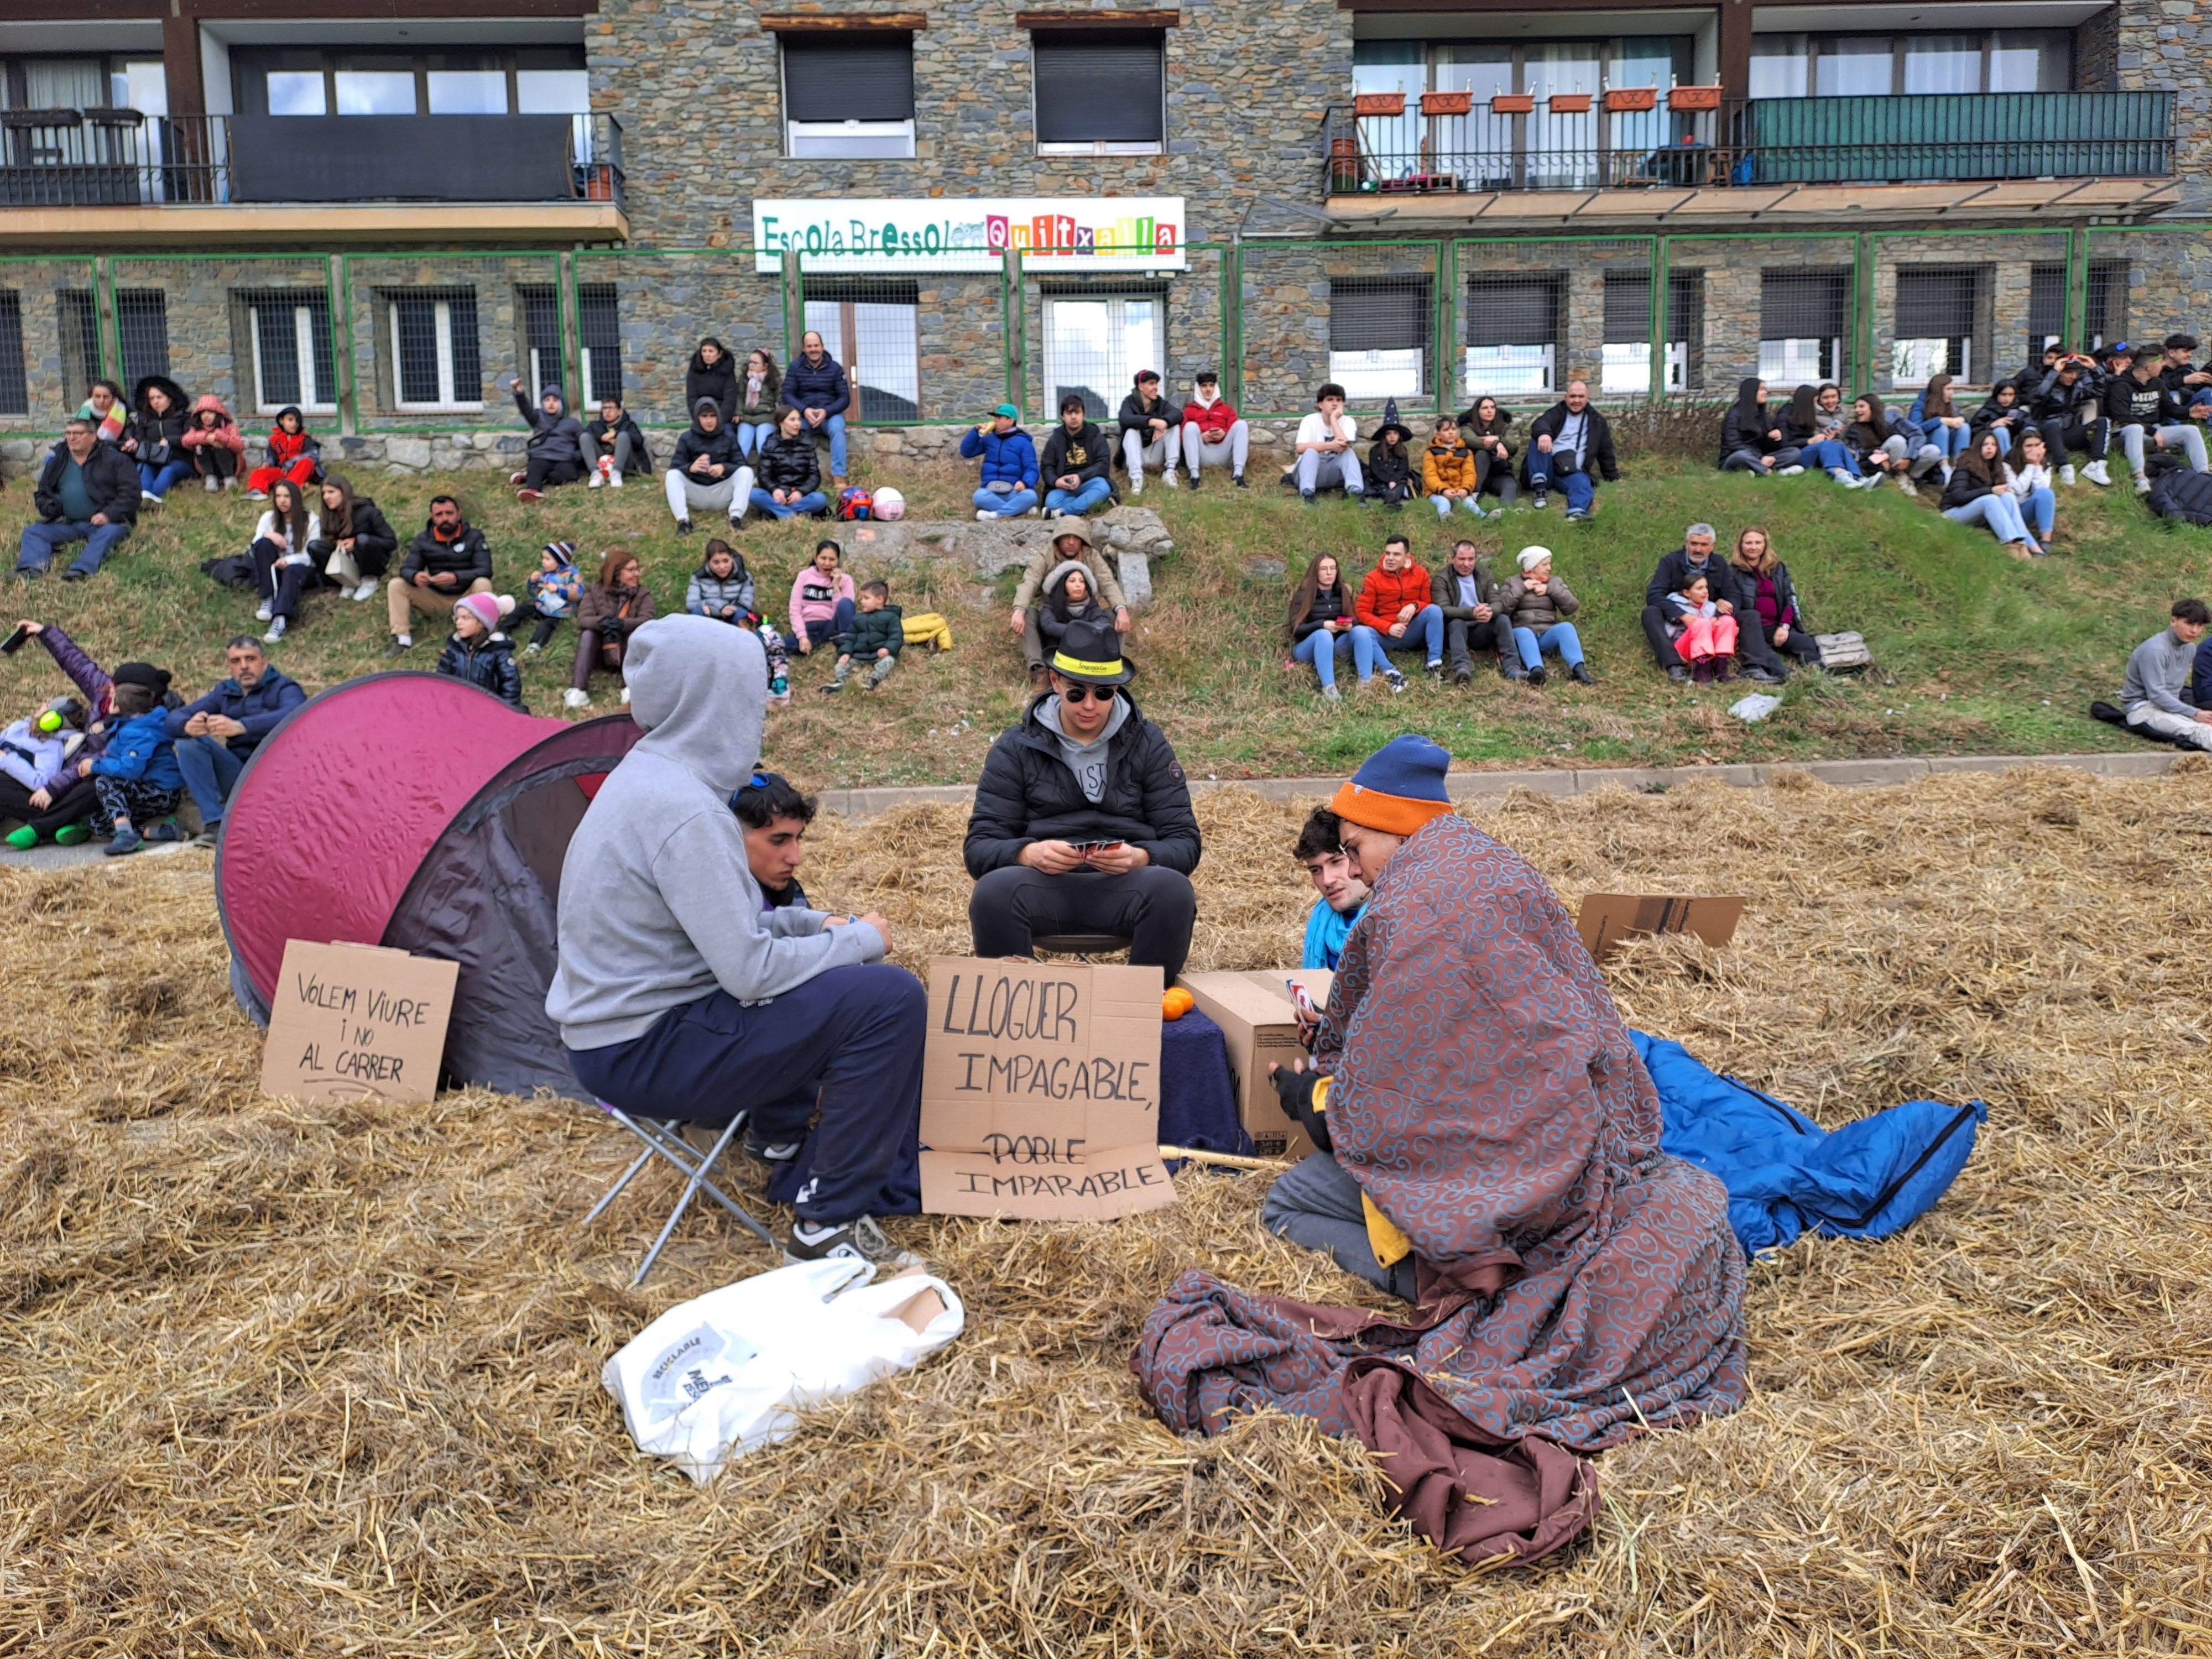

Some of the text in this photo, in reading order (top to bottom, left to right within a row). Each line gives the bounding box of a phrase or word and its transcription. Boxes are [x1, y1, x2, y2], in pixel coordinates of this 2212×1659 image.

[762, 215, 1175, 257] Escola Bressol Quitxalla
[298, 972, 357, 1014] VOLEM
[943, 974, 1078, 1043] LLOGUER
[353, 1025, 374, 1047] NO
[299, 1042, 404, 1084] AL CARRER
[954, 1053, 1153, 1112] IMPAGABLE,
[982, 1133, 1086, 1165] POBLE
[954, 1164, 1165, 1198] IMPARABLE
